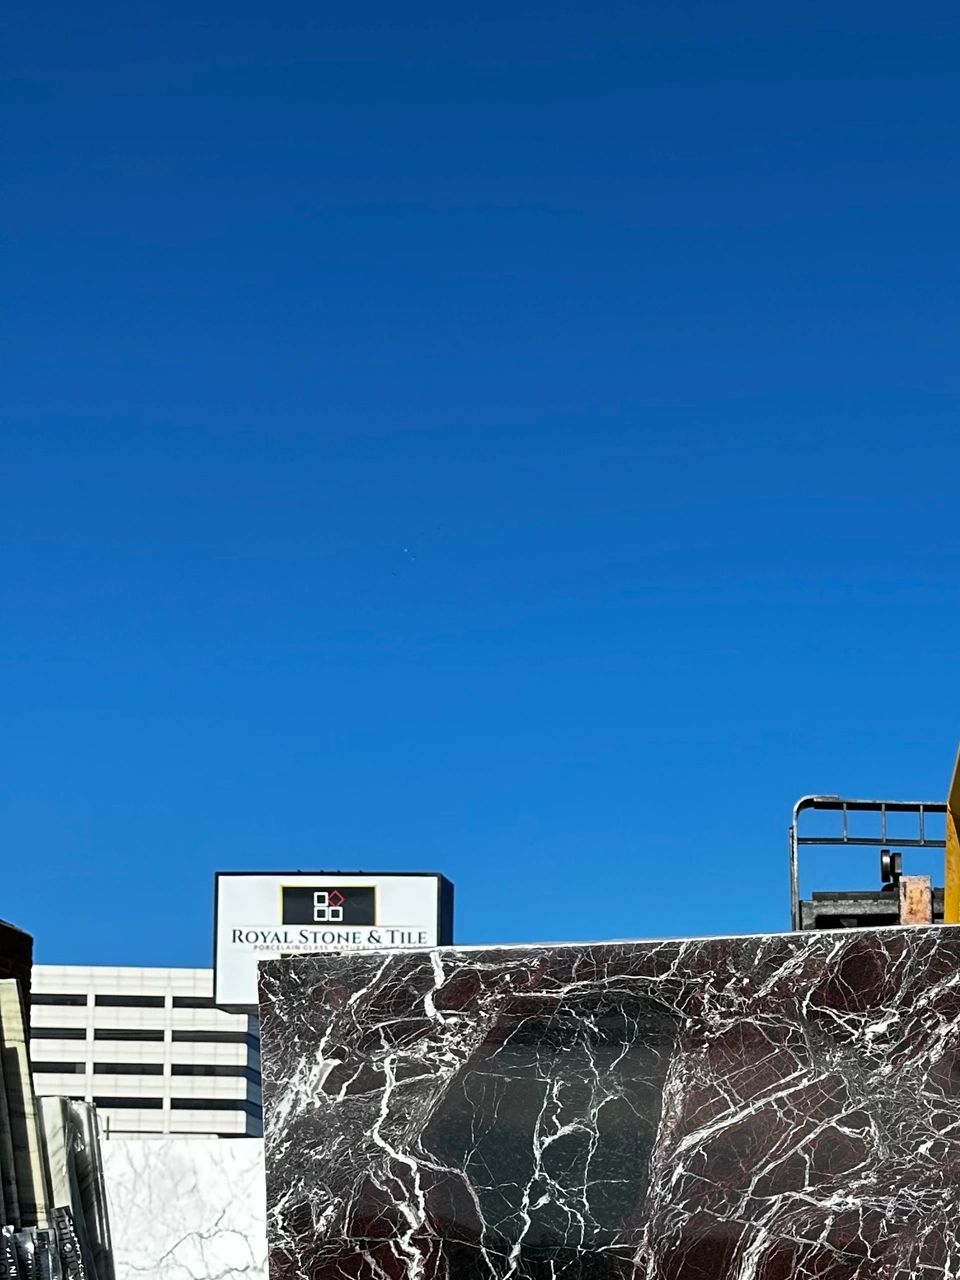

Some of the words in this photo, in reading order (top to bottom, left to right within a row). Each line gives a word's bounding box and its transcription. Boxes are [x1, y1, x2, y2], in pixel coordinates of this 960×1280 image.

[232, 929, 294, 944] ROYAL
[298, 929, 362, 944] STONE
[367, 929, 382, 944] &
[386, 929, 428, 944] TILE
